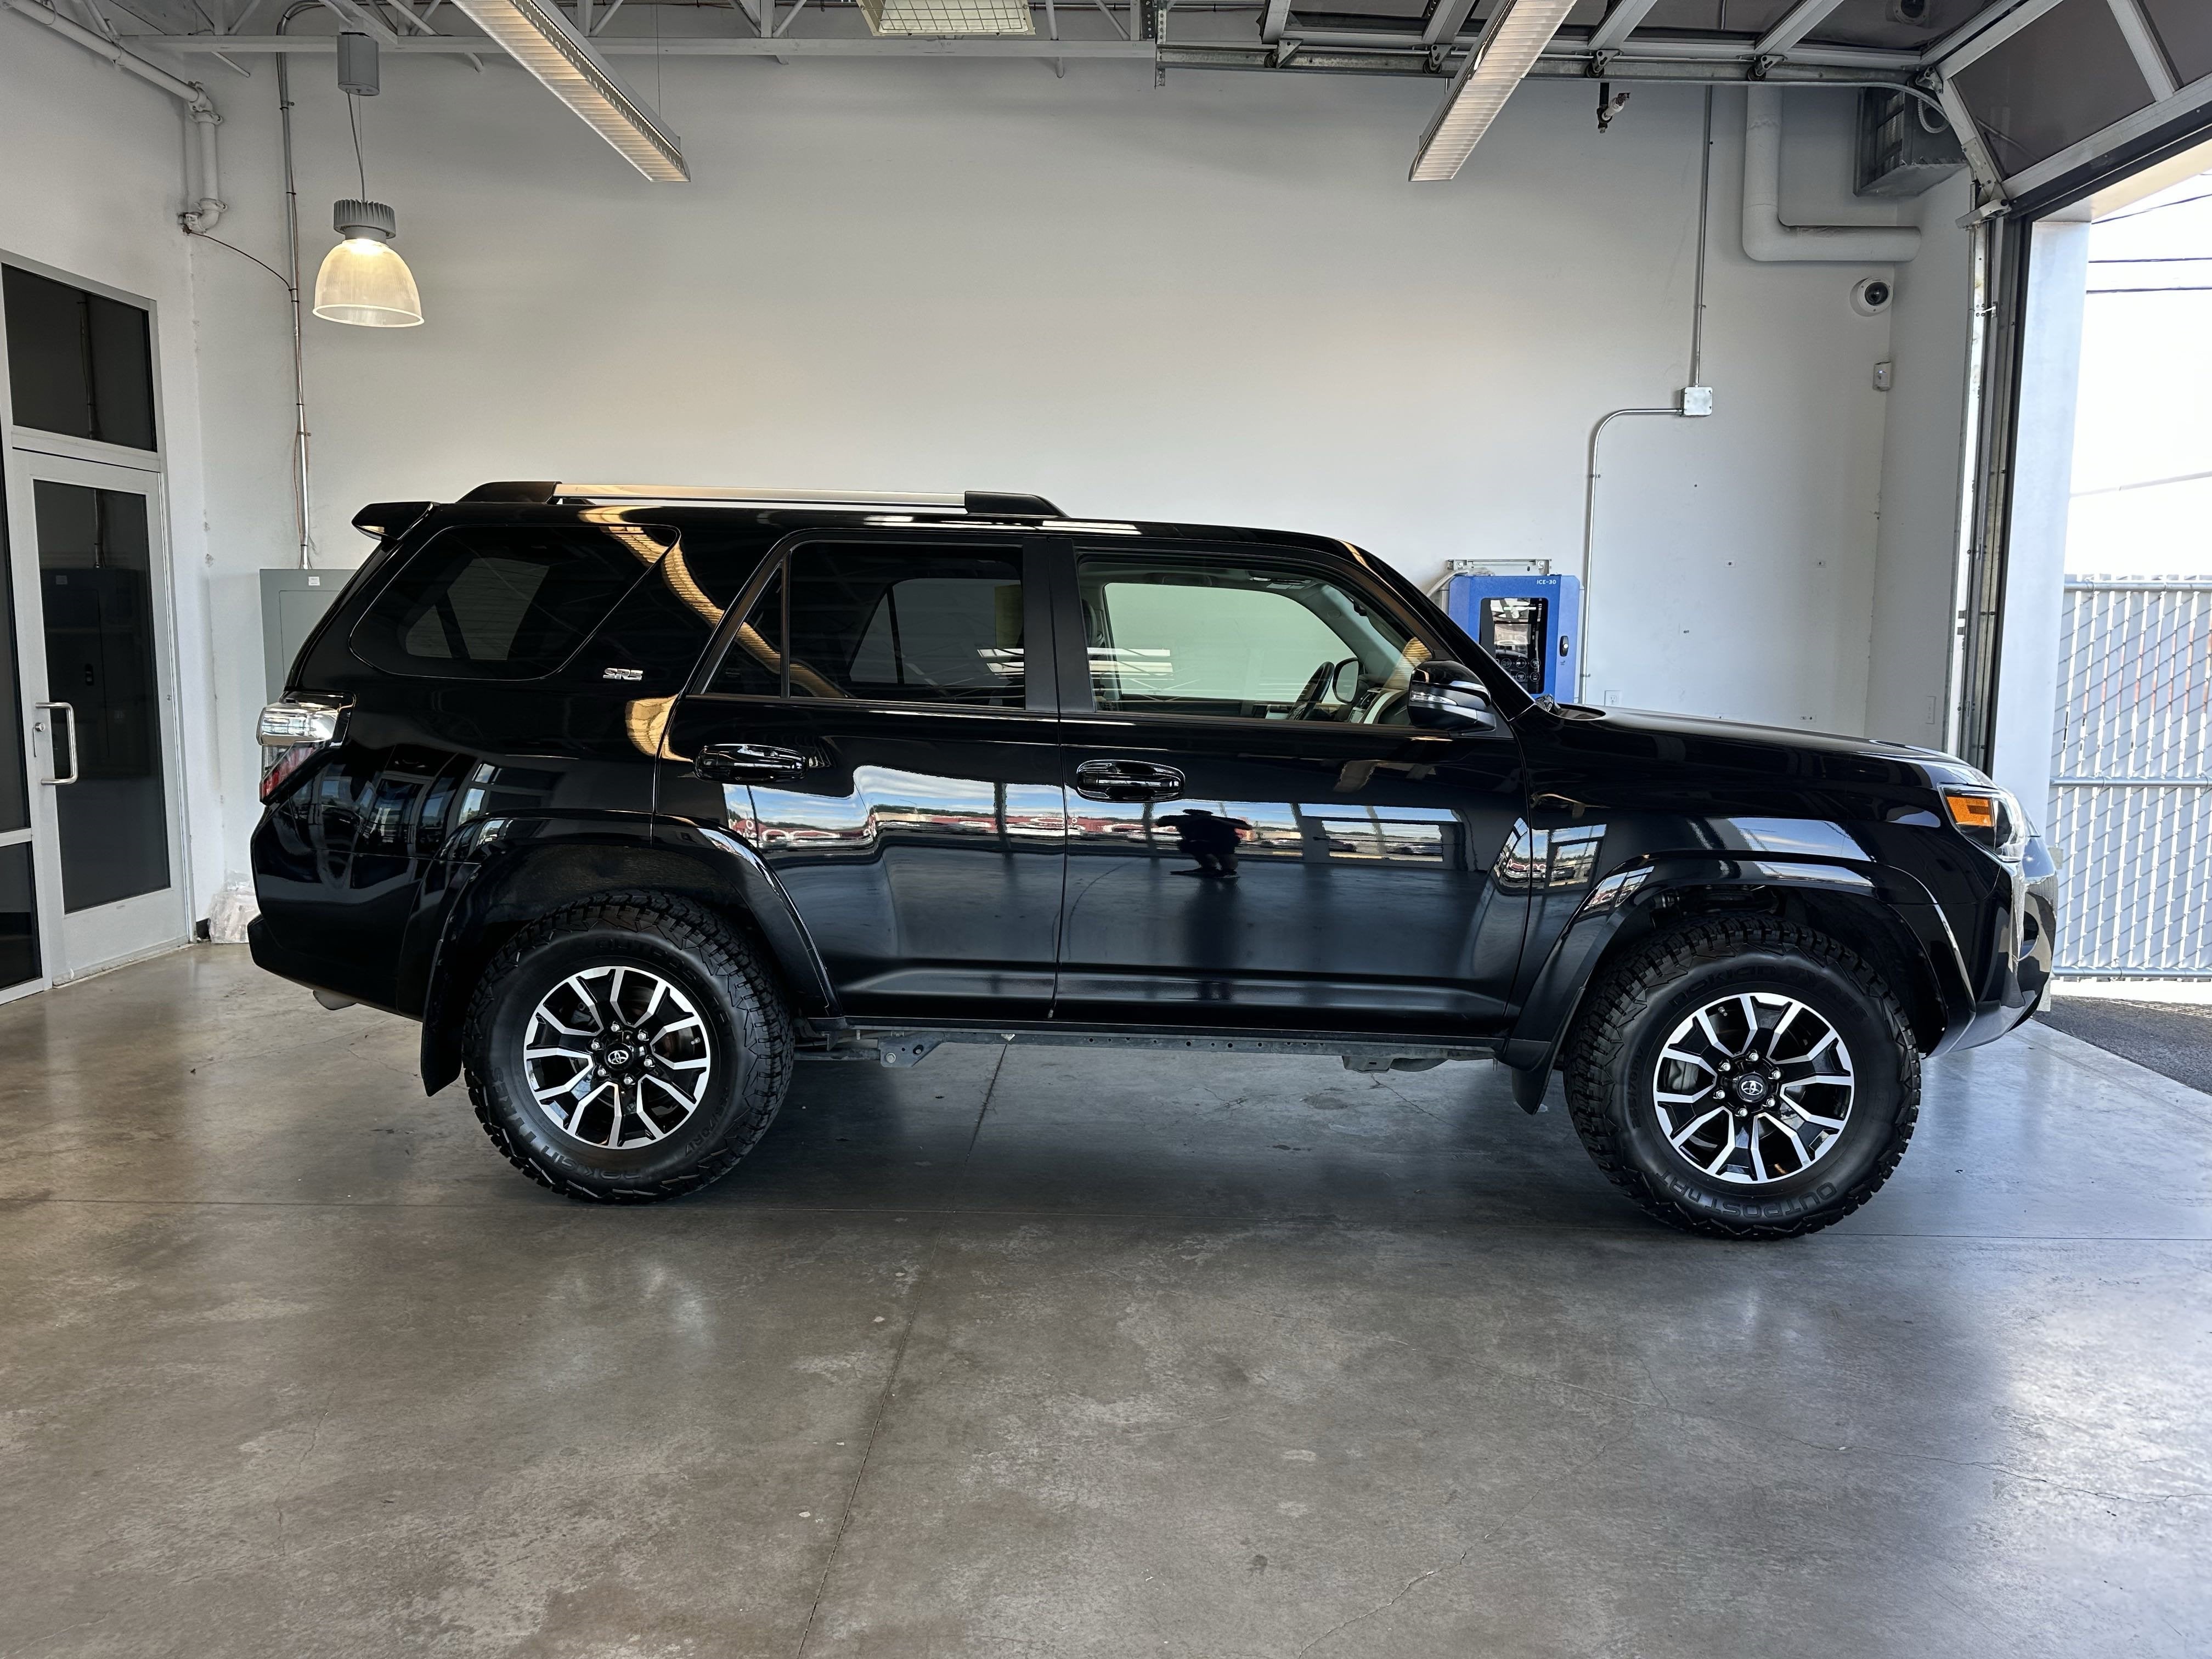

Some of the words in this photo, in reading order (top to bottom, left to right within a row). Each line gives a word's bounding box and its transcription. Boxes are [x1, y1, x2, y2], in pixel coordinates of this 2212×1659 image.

[603, 668, 644, 681] SR5
[493, 1067, 537, 1143] TYRES
[1705, 1182, 1837, 1218] OUTPOST
